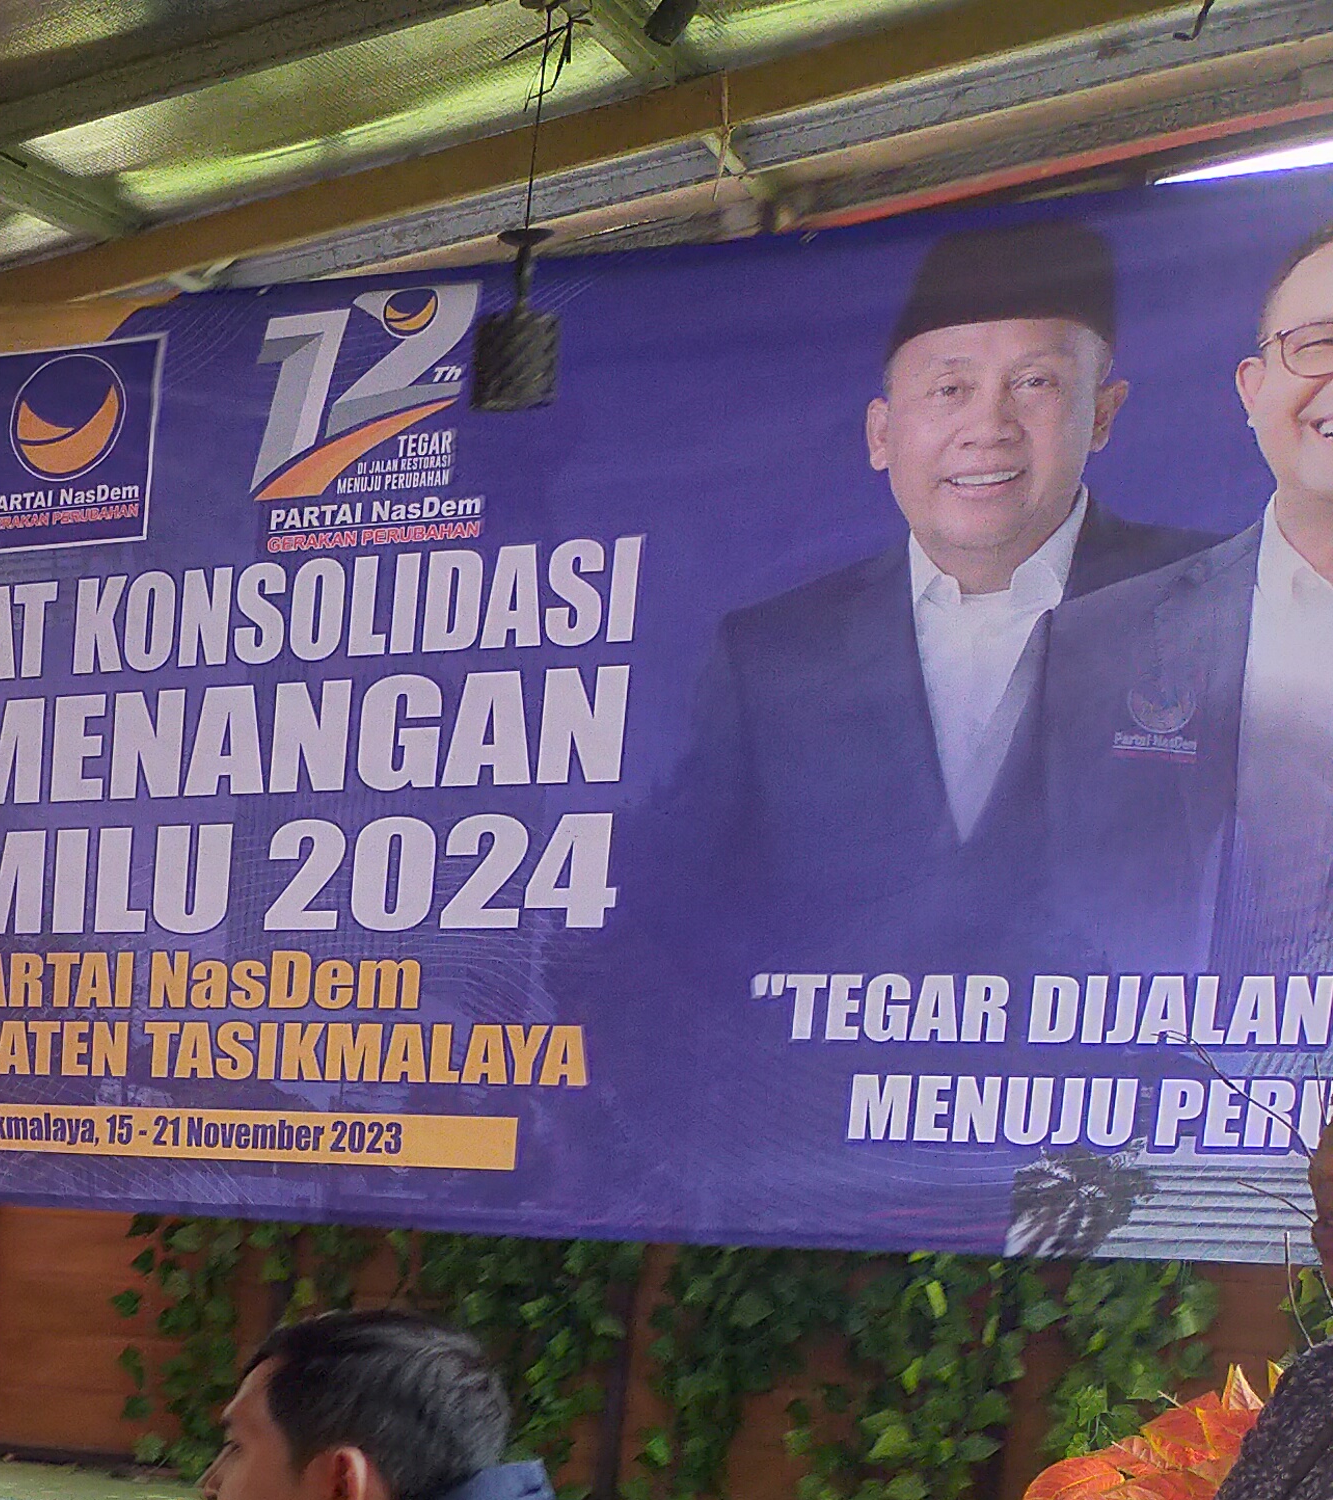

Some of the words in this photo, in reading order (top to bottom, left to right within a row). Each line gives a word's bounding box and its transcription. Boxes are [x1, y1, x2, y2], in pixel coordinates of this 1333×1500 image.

[397, 430, 452, 458] TEGAR
[336, 475, 381, 494] MENUJU
[384, 469, 449, 491] PERUBAHAN
[357, 461, 367, 474] DI
[369, 458, 398, 473] JALAN
[400, 454, 451, 471] RESTORASI
[52, 503, 139, 525] PERUBAHAN
[60, 485, 139, 506] NasDem
[270, 502, 362, 530] PARTAI
[371, 496, 481, 523] NasDem
[267, 530, 358, 553] GERAKAN
[361, 521, 480, 545] PERUBAHAN
[73, 535, 645, 675] KONSOLIDASI
[264, 812, 617, 931] 2024
[148, 950, 421, 1010] NasDem
[750, 972, 1010, 1044] "TEGAR
[1028, 974, 1333, 1046] DIJALAN
[145, 1020, 588, 1088] TASIKMALAYA
[847, 1074, 1139, 1146] MENUJU
[106, 1114, 132, 1145] 15
[152, 1115, 181, 1147] 21
[187, 1117, 325, 1153] November
[330, 1120, 402, 1154] 2023
